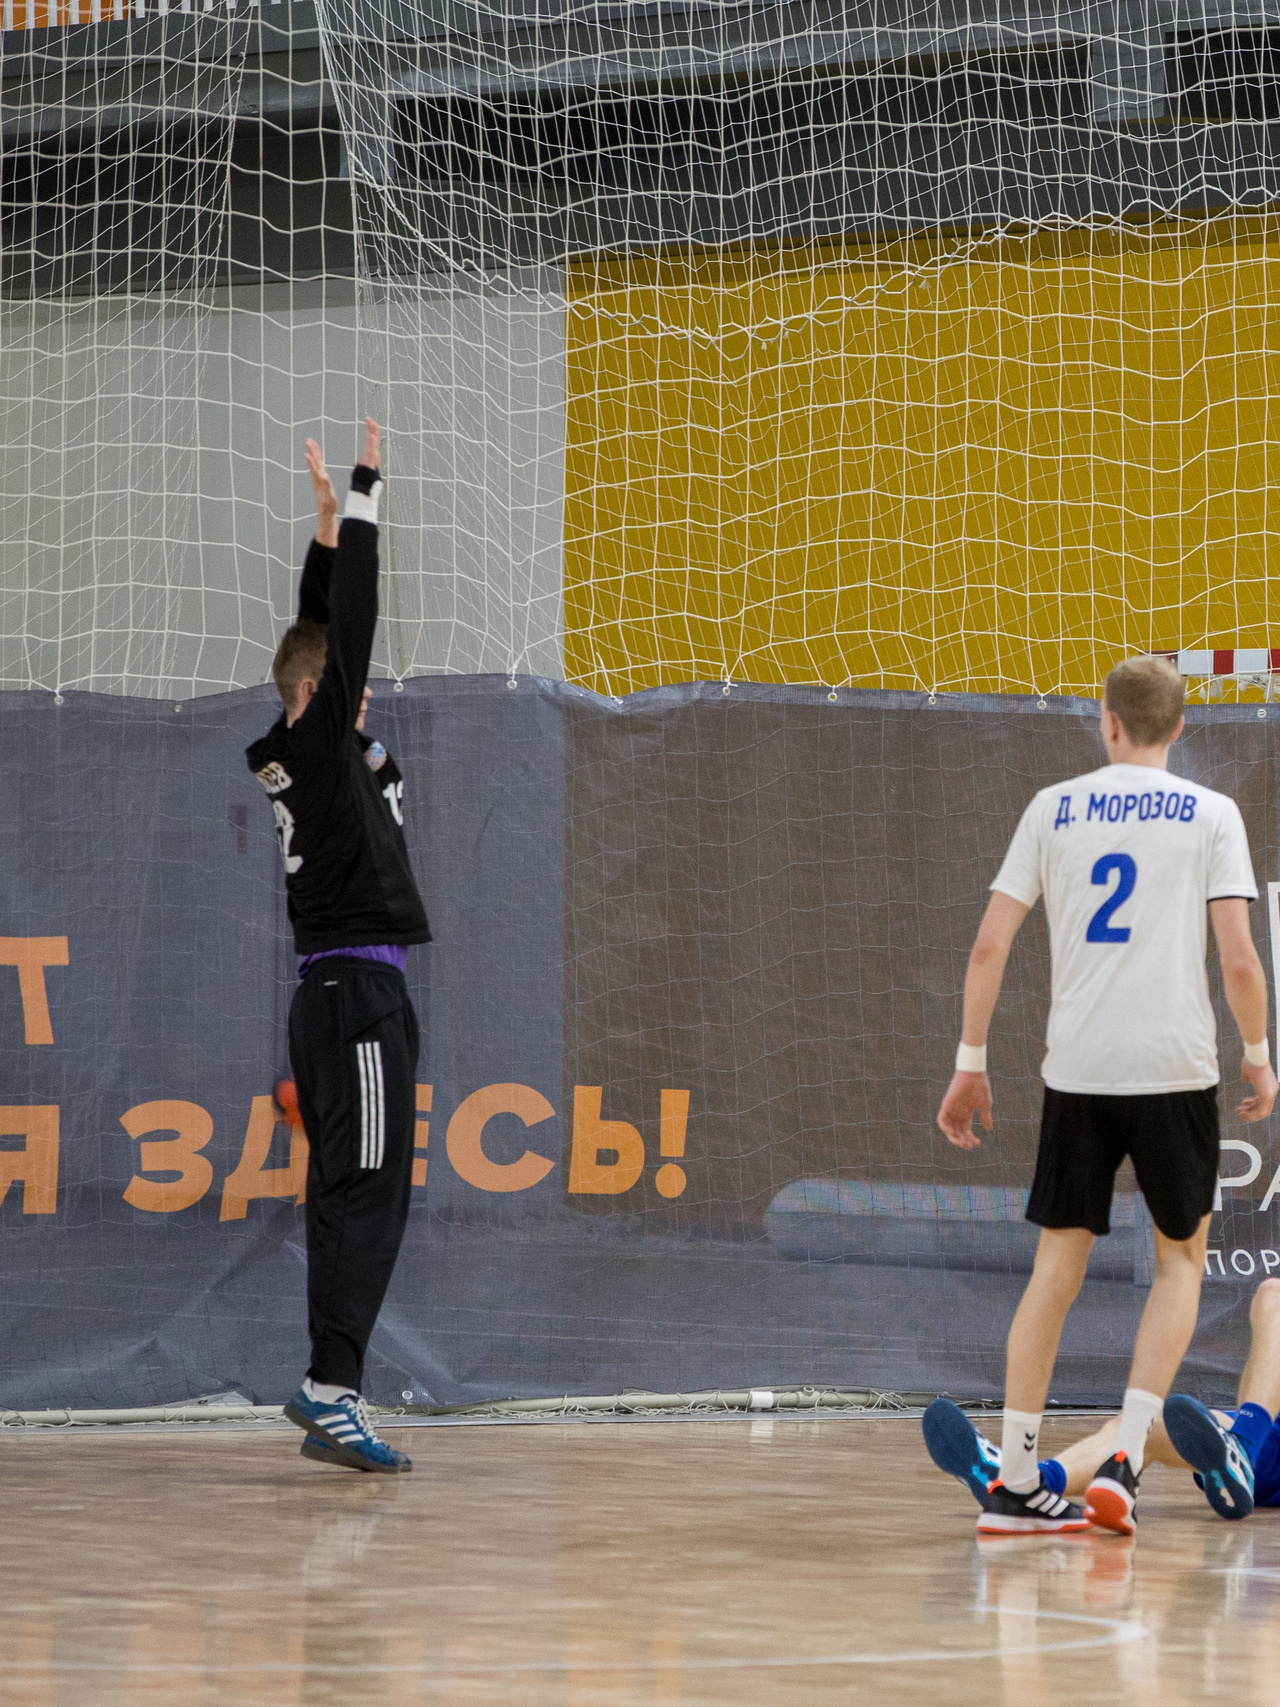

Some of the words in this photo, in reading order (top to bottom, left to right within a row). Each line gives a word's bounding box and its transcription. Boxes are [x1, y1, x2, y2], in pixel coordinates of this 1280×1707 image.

[1054, 795, 1077, 831] Д.
[1086, 790, 1198, 823] МОРОЗОВ
[1085, 852, 1138, 943] 2
[118, 1082, 691, 1222] ЗДСЬ!
